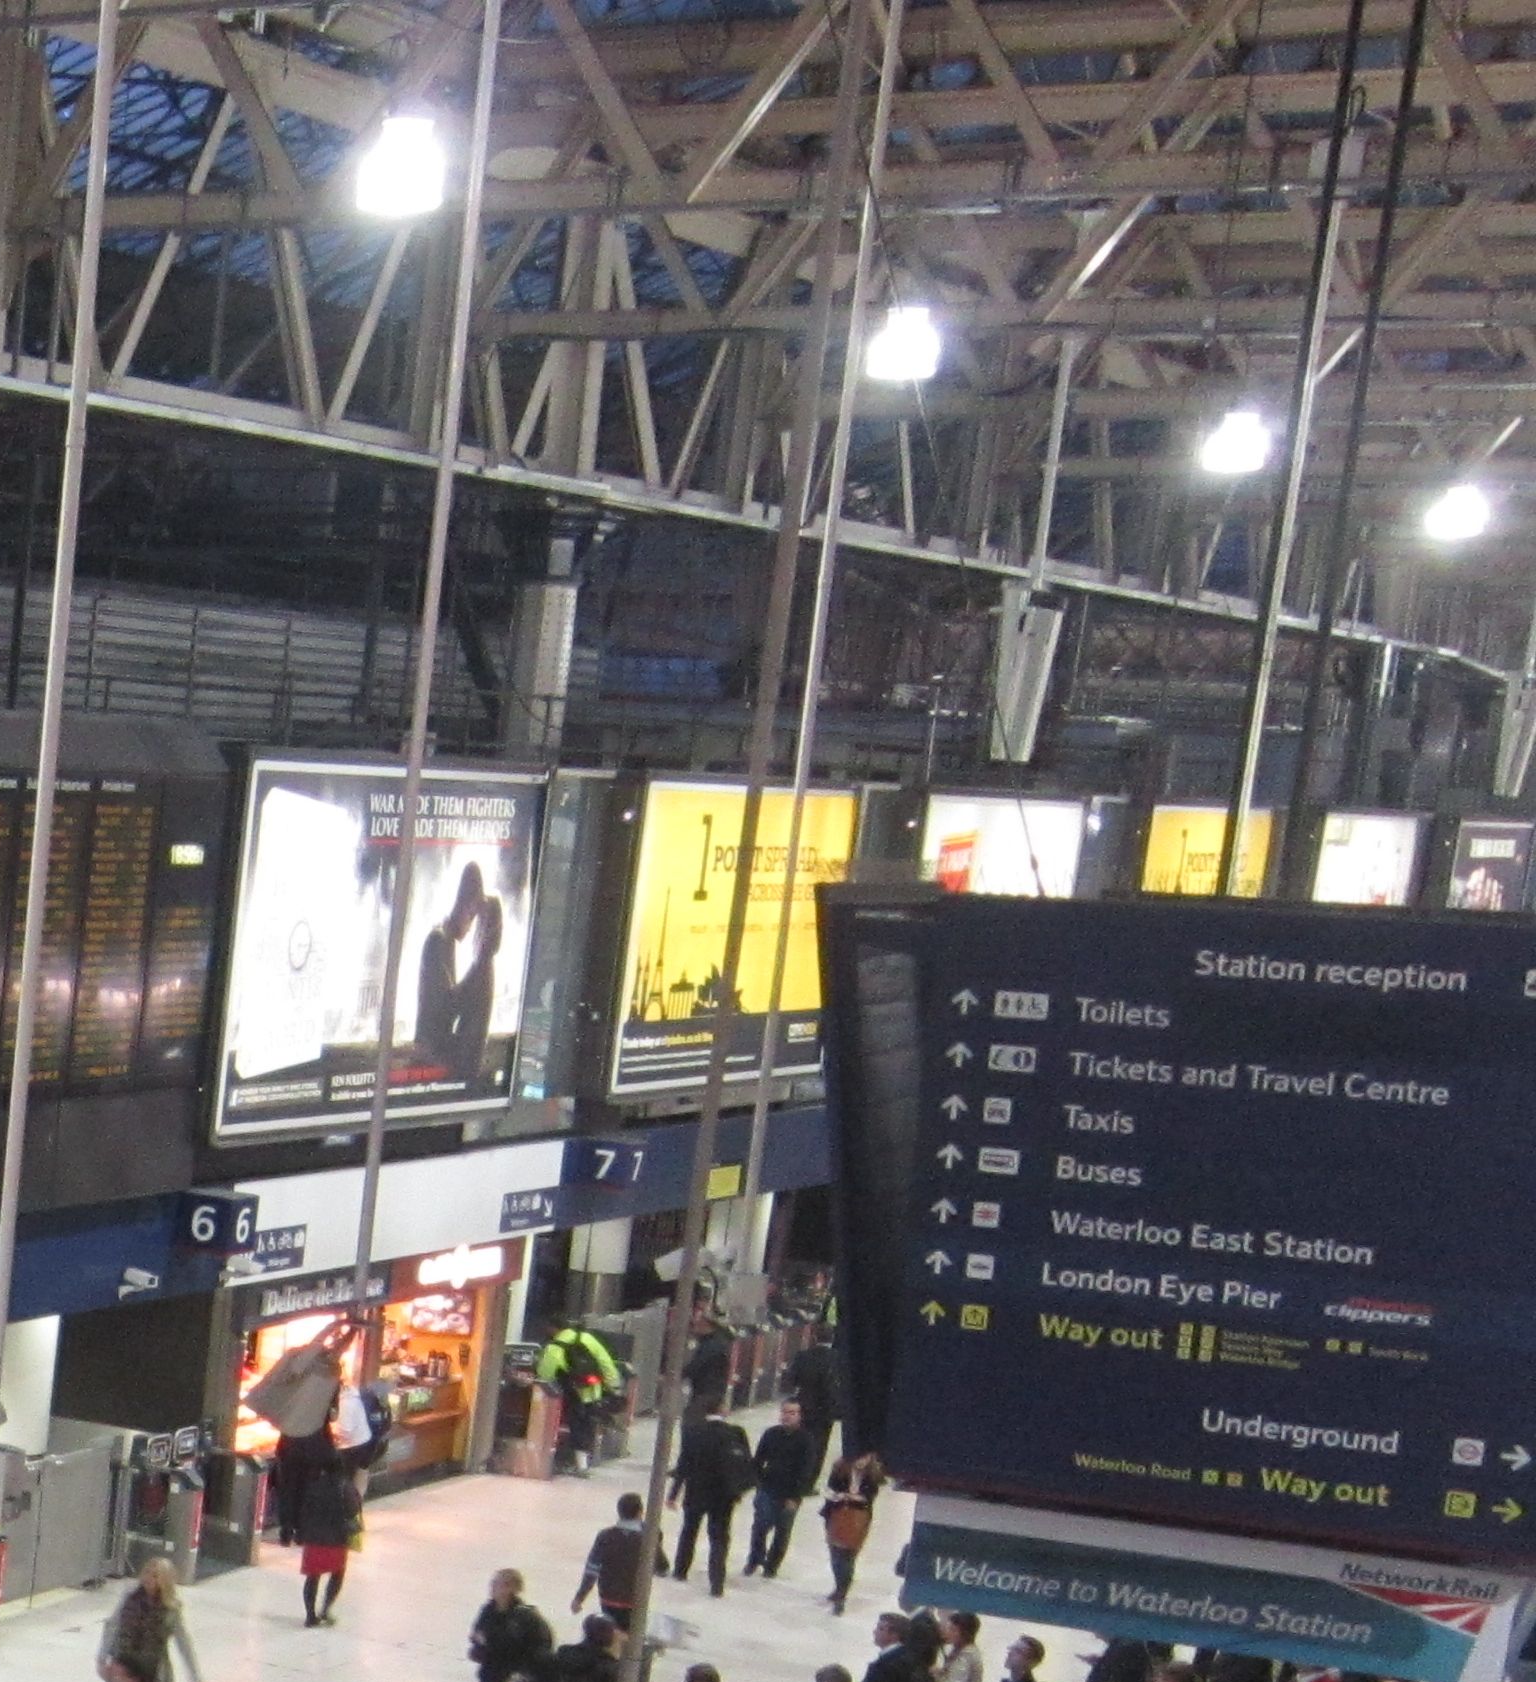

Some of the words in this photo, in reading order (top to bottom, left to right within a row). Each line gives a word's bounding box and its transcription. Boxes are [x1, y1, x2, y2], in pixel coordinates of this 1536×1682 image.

[370, 794, 395, 813] WAR
[433, 796, 464, 816] THEM
[467, 797, 516, 817] FIGHTERS
[371, 817, 400, 836] LOVE
[437, 819, 469, 838] THEM
[472, 820, 510, 839] HEROES
[1196, 952, 1305, 981] Station
[1316, 956, 1466, 993] reception
[1078, 998, 1170, 1027] Toilets
[1070, 1052, 1172, 1084] Tickets
[1183, 1064, 1236, 1089] and
[1249, 1065, 1334, 1095] Travel
[1345, 1074, 1449, 1105] Centre
[1065, 1106, 1134, 1134] Taxis
[595, 1149, 616, 1180] 7
[1056, 1155, 1142, 1186] Buses
[191, 1206, 216, 1241] 6
[236, 1207, 250, 1243] 6
[1052, 1210, 1181, 1246] Waterloo
[1192, 1225, 1254, 1254] East
[1264, 1232, 1374, 1266] Station
[1042, 1262, 1149, 1297] London
[1161, 1277, 1214, 1308] Eye
[1224, 1284, 1281, 1311] Pier
[1039, 1314, 1103, 1348] Way
[1110, 1327, 1163, 1350] out
[1324, 1304, 1430, 1325] clippers
[1203, 1408, 1399, 1454] Underground
[1075, 1453, 1145, 1475] Waterloo
[1151, 1464, 1191, 1480] Road
[1261, 1467, 1329, 1503] Way
[1336, 1480, 1389, 1508] out
[934, 1556, 1059, 1598] Welcome
[1068, 1580, 1098, 1602] to
[1105, 1582, 1248, 1626] Waterloo
[1254, 1608, 1372, 1644] Station
